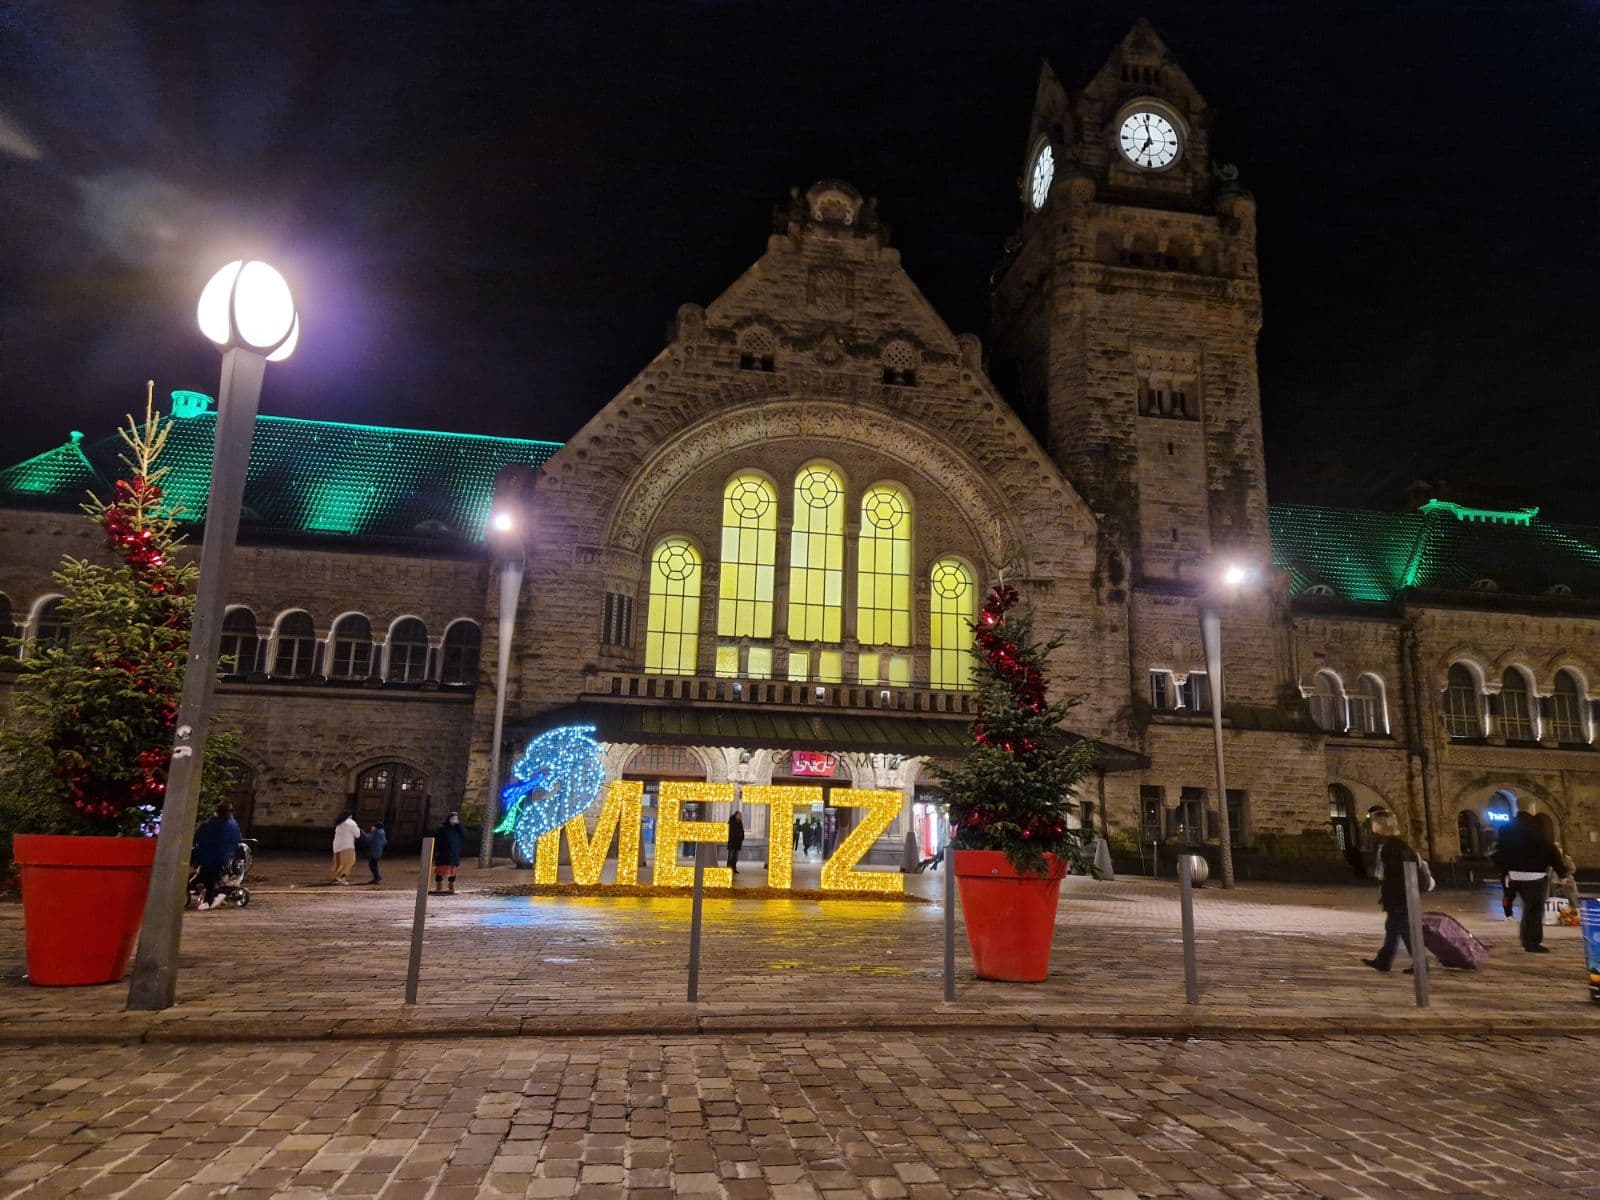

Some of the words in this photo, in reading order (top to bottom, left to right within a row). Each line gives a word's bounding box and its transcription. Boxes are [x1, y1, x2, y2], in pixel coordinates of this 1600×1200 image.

[771, 751, 817, 768] GRE
[826, 754, 847, 767] DE
[856, 756, 899, 770] METZ
[794, 759, 835, 773] SNCF
[534, 779, 904, 892] METZ
